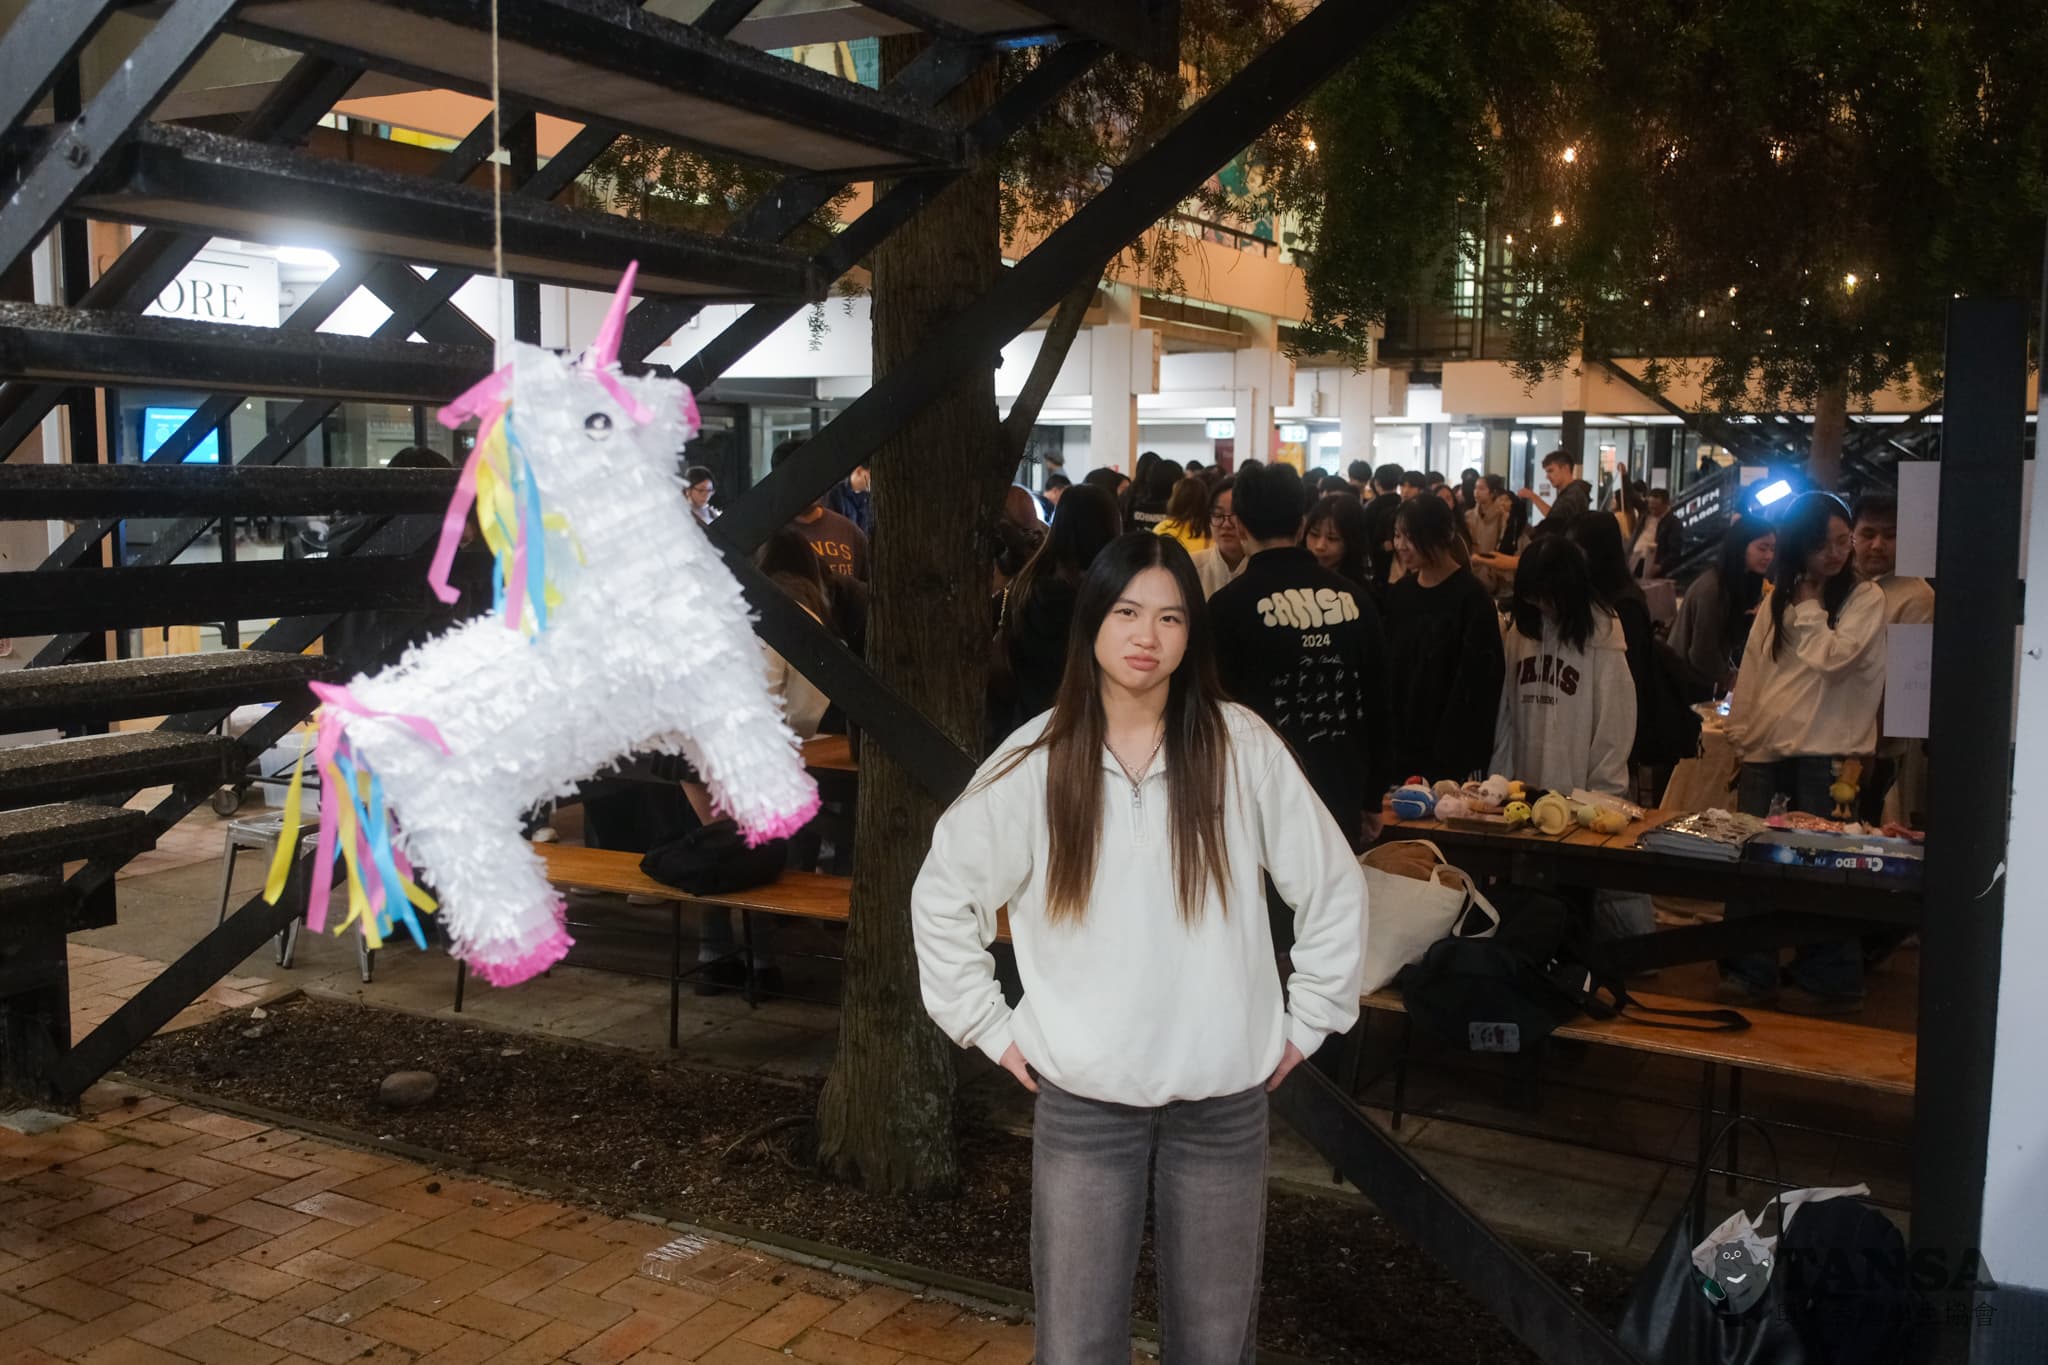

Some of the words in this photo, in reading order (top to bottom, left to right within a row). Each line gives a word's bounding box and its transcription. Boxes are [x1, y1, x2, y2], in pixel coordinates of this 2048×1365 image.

[157, 278, 246, 321] ORE
[1257, 588, 1359, 630] TANSA
[1302, 634, 1331, 647] 2024
